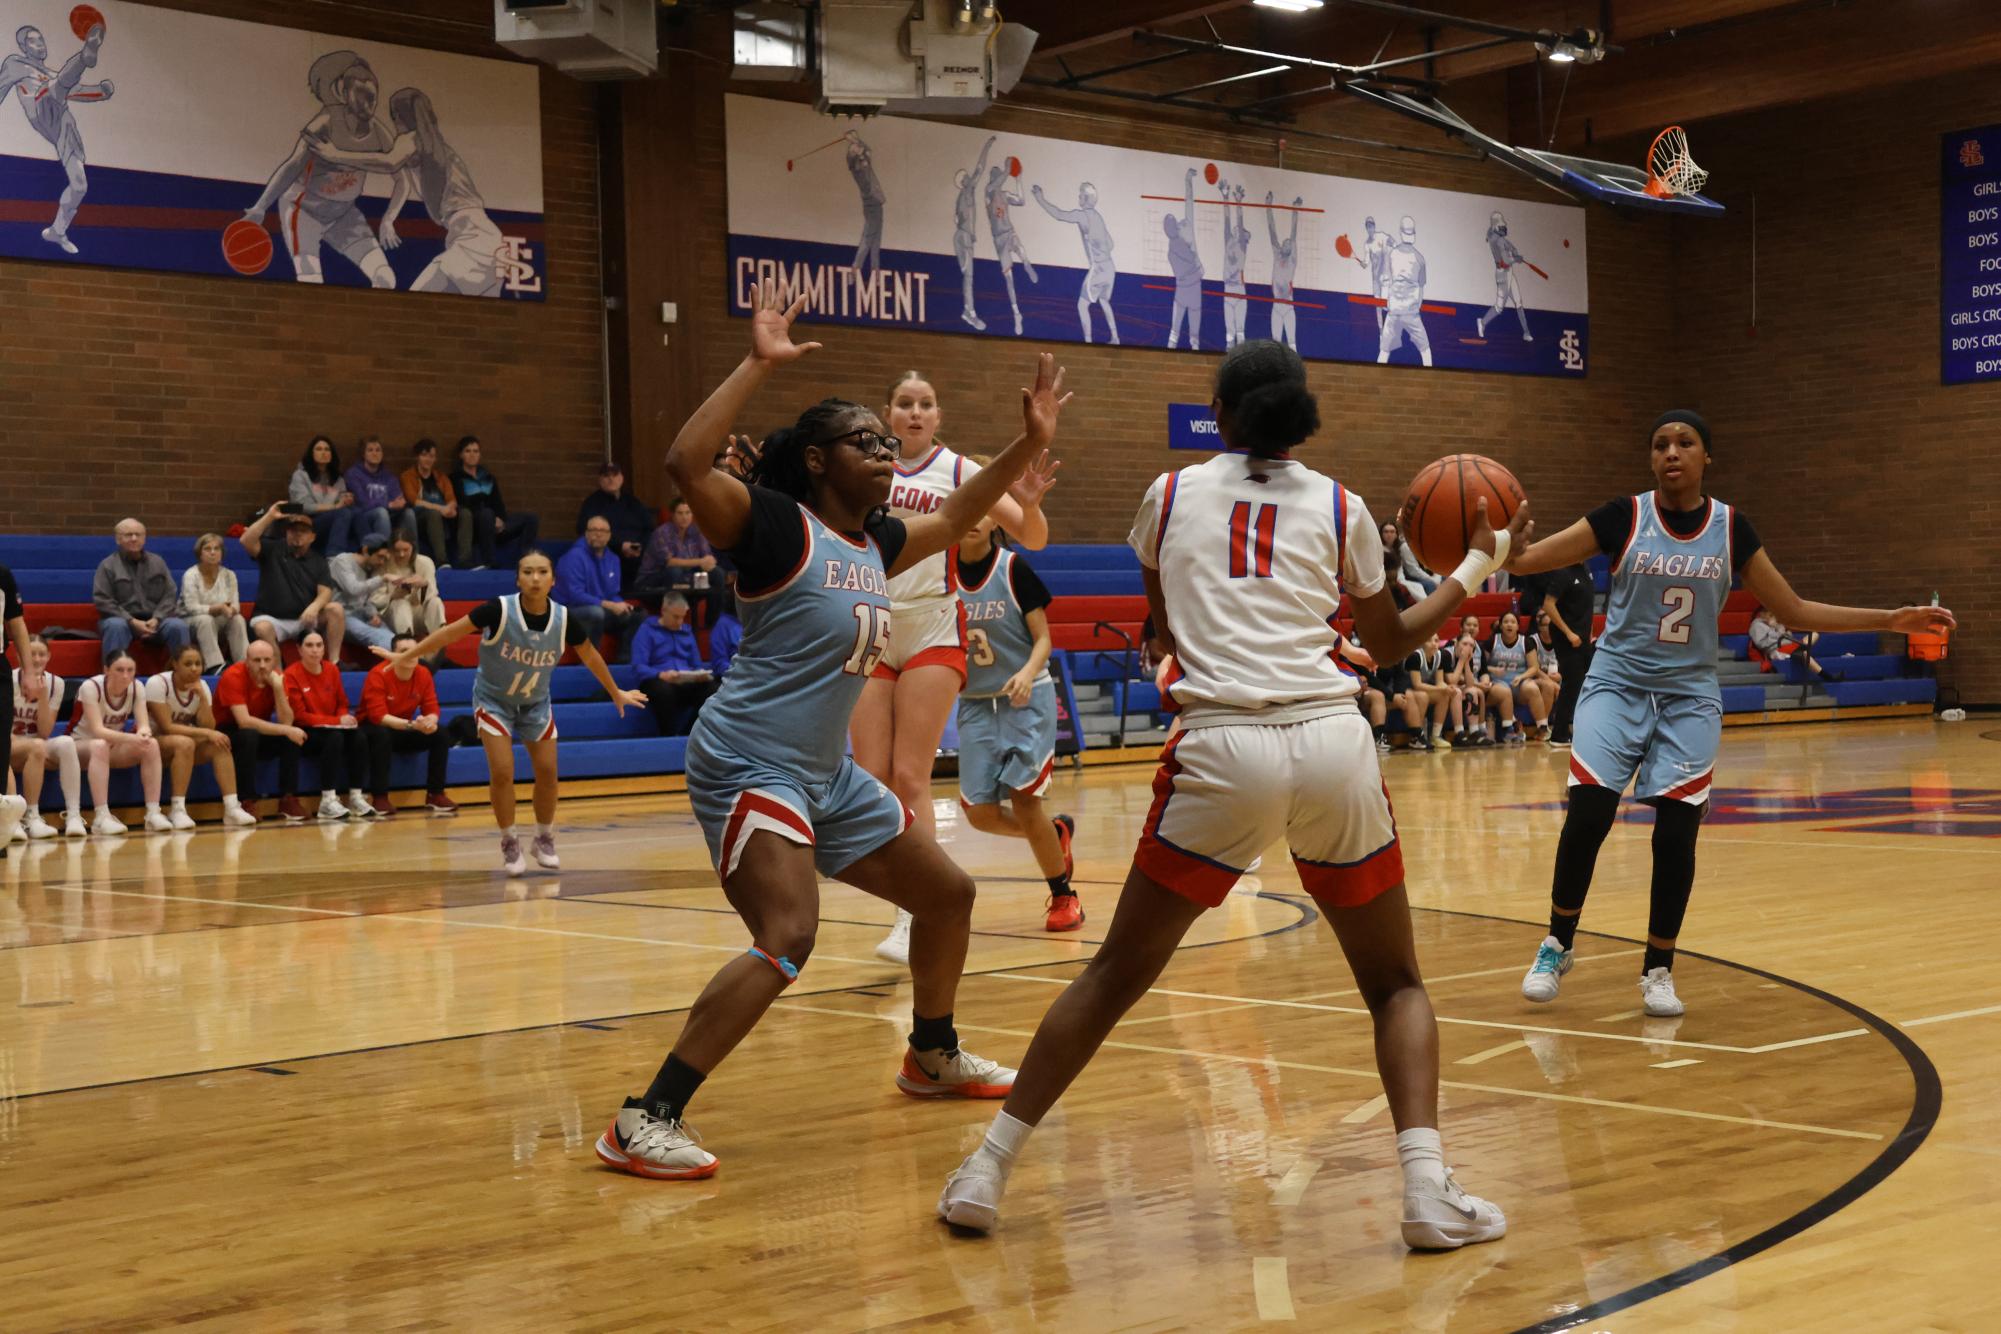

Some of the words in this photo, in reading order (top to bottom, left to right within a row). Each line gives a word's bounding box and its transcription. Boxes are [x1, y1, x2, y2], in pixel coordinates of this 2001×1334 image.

[1968, 207, 1999, 223] BOYS
[1968, 232, 1999, 248] BOYS
[736, 256, 930, 323] COMMITMENT
[1972, 283, 2001, 298] BOYS
[1951, 310, 1980, 325] GIRLS
[1952, 336, 1979, 350] BOYS
[1190, 420, 1219, 434] VISITO
[886, 486, 945, 515] CONS
[1228, 501, 1278, 578] 11
[1631, 551, 1723, 580] EAGLES
[1658, 586, 1695, 644] 2
[842, 602, 891, 678] 15
[500, 640, 557, 668] EAGLES
[506, 671, 541, 698] 14
